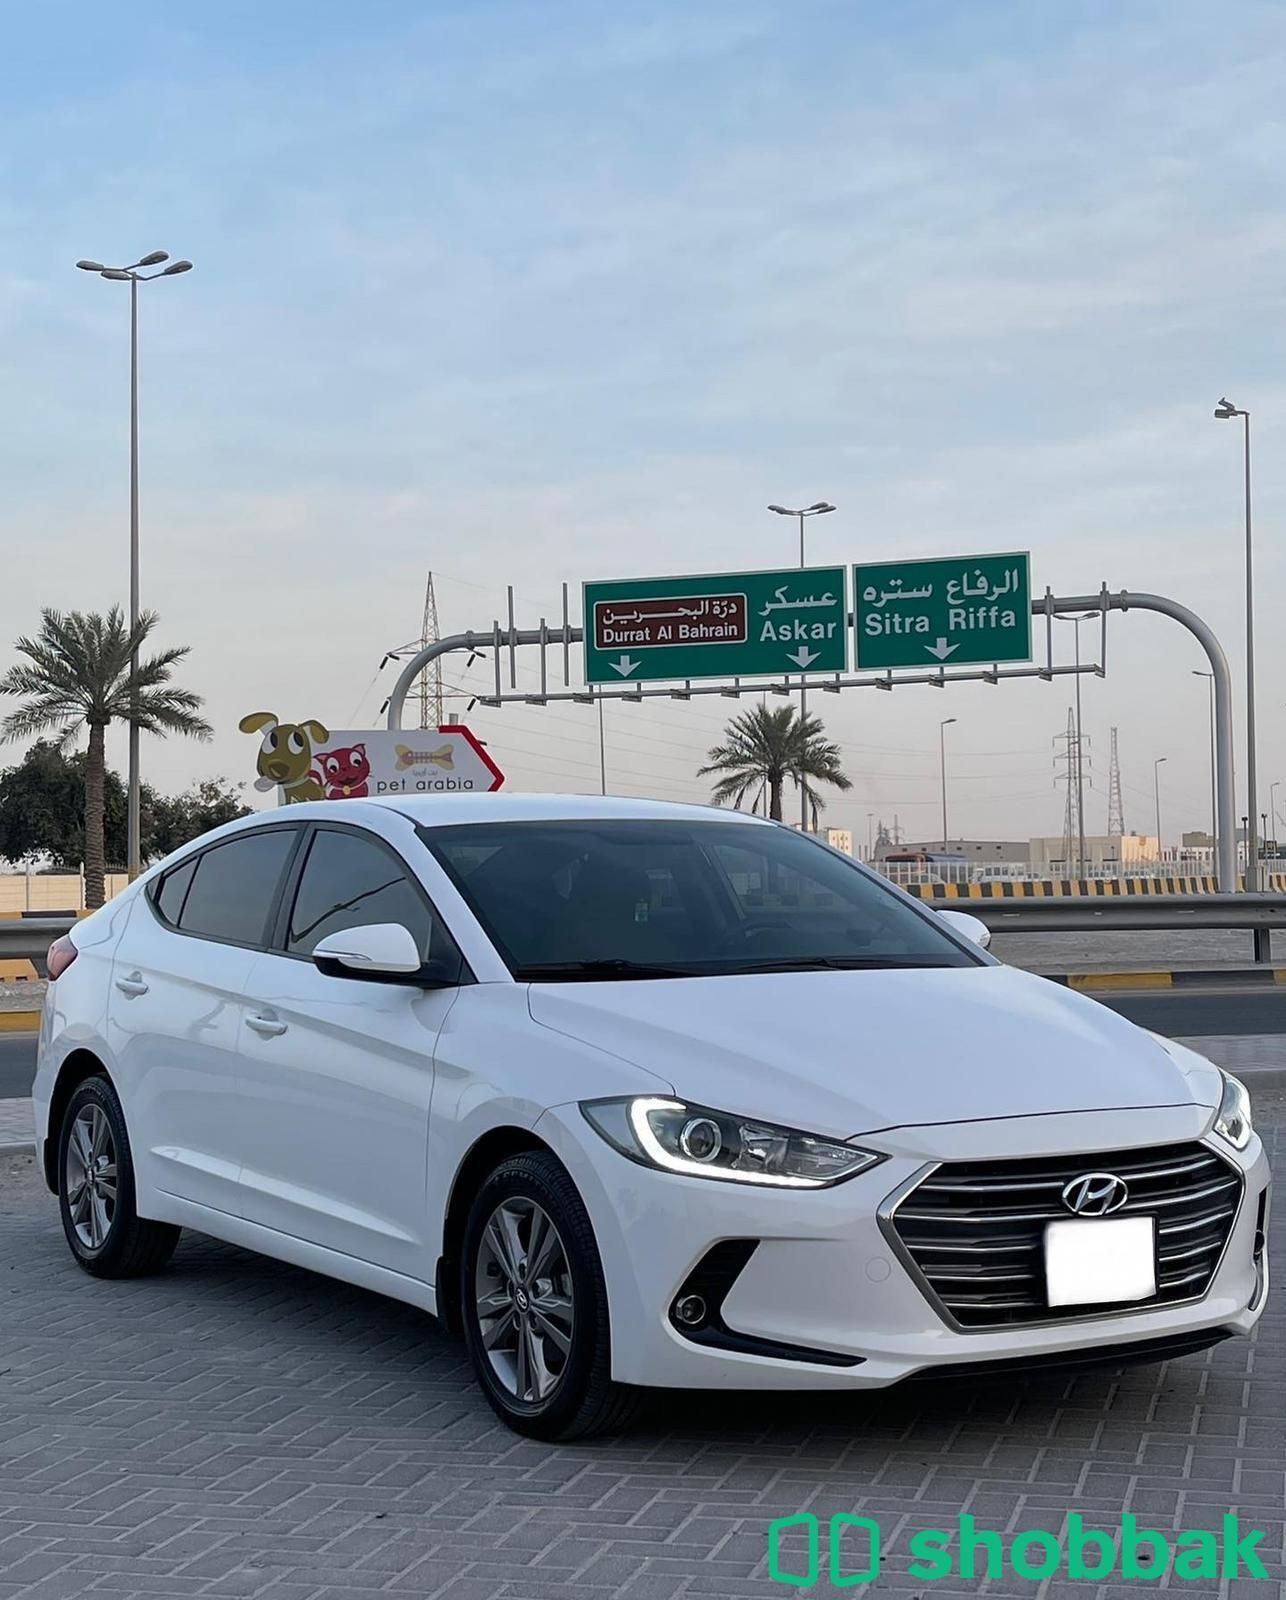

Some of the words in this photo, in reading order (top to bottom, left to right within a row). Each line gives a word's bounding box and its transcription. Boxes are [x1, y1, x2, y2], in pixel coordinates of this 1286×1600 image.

[863, 579, 932, 608] ستره
[946, 567, 1018, 605] الرفاع
[602, 600, 709, 625] البحرين
[757, 585, 837, 616] عسكر
[603, 627, 651, 643] Durrat
[657, 625, 672, 640] Al
[679, 622, 738, 639] Bahrain
[759, 619, 836, 642] Askar
[865, 613, 929, 636] Sitra
[950, 605, 1016, 631] Riffa
[377, 778, 406, 793] pet
[415, 777, 474, 791] arabia
